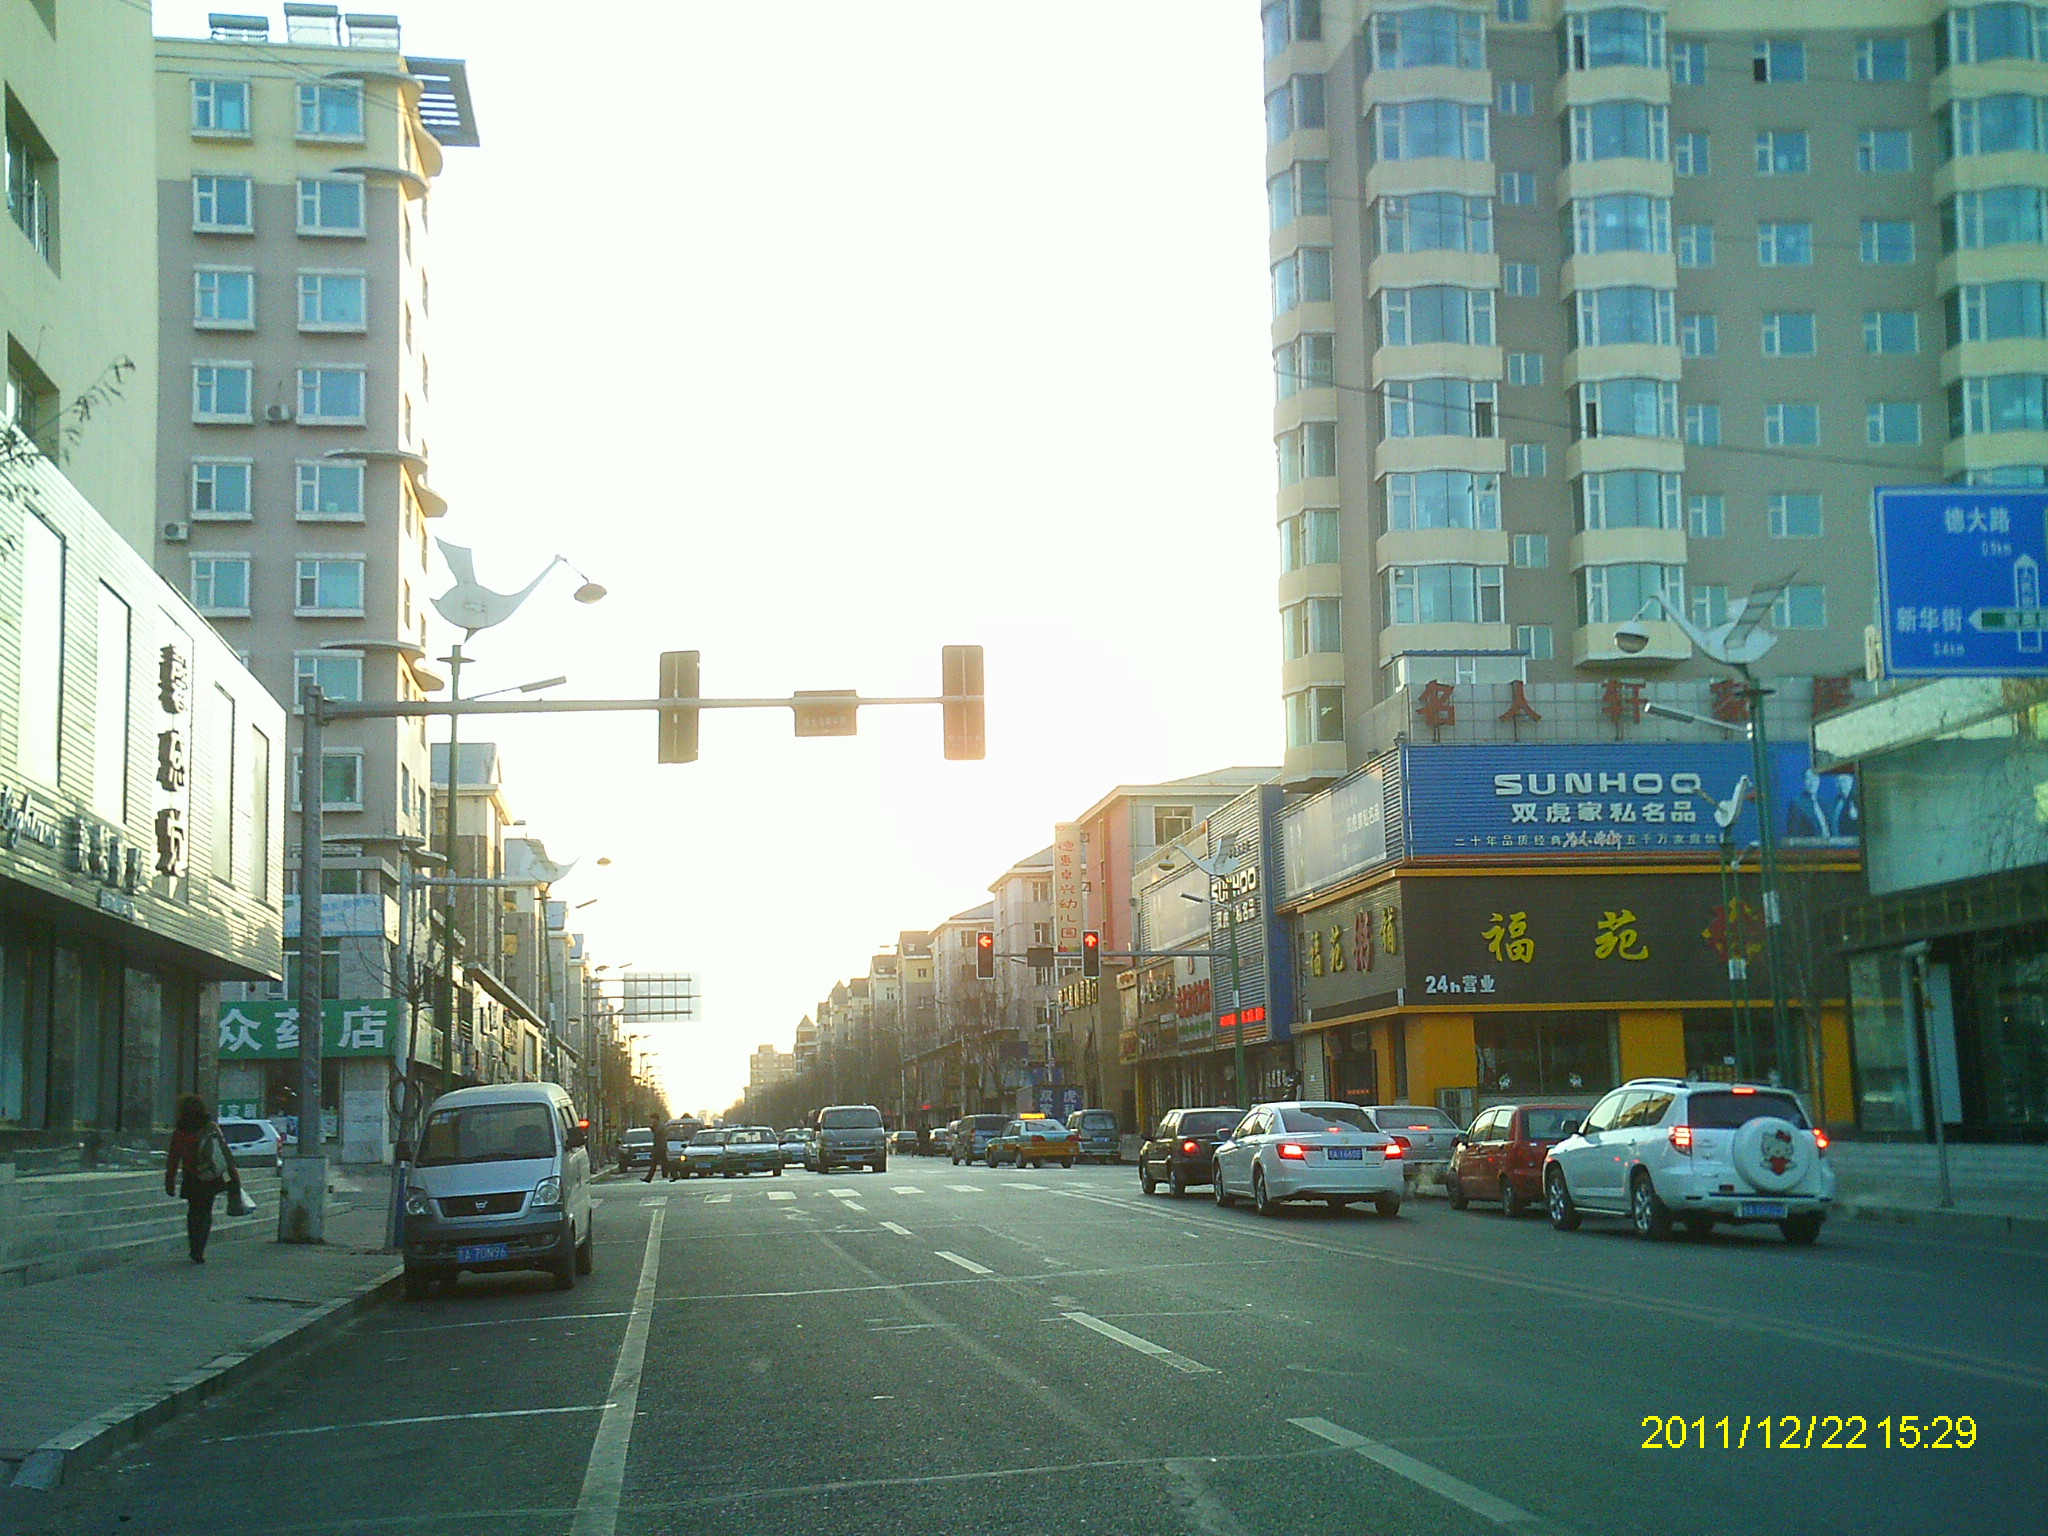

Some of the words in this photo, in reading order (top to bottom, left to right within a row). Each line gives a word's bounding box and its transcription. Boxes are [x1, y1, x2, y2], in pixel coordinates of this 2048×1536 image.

[1896, 605, 1963, 634] 新华街
[1511, 801, 1697, 824] 双虎家私名品
[1481, 909, 1650, 964] 福苑
